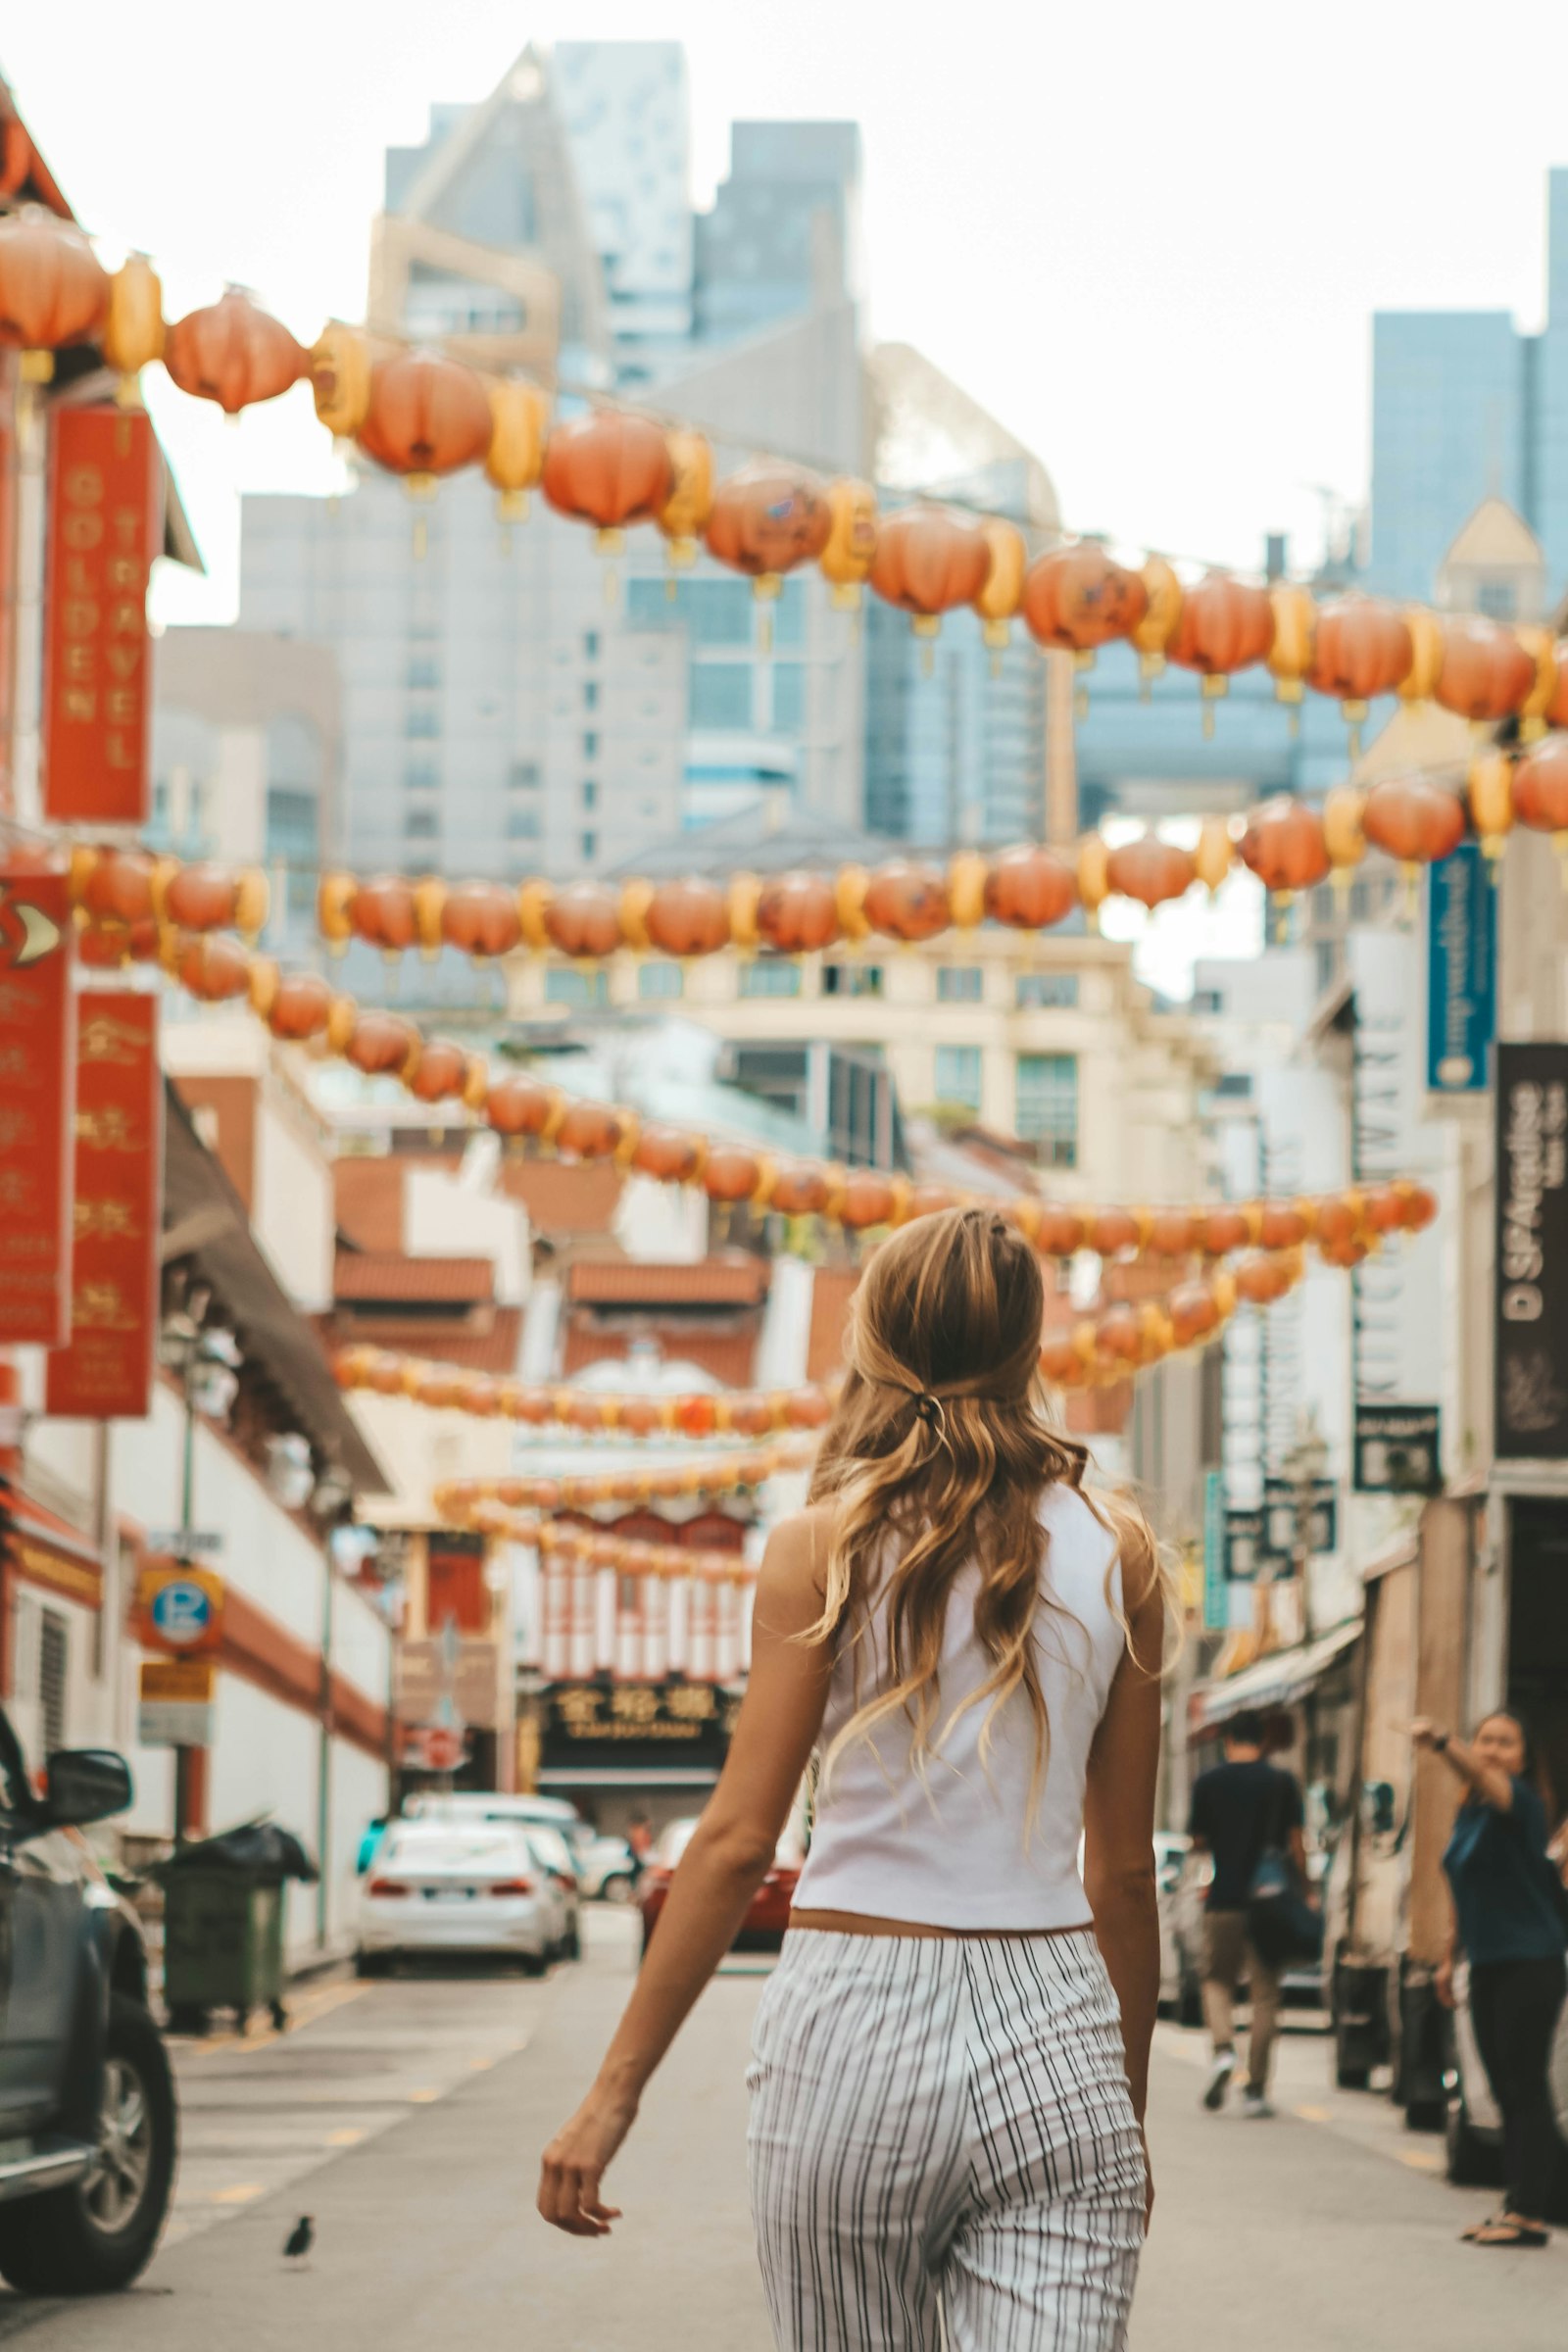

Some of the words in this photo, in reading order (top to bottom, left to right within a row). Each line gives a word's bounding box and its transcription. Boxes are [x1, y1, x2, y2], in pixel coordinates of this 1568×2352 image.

[63, 463, 104, 724] GOLDEN
[105, 506, 140, 769] TRAVEL
[1356, 1011, 1403, 1401] KITCHWARE
